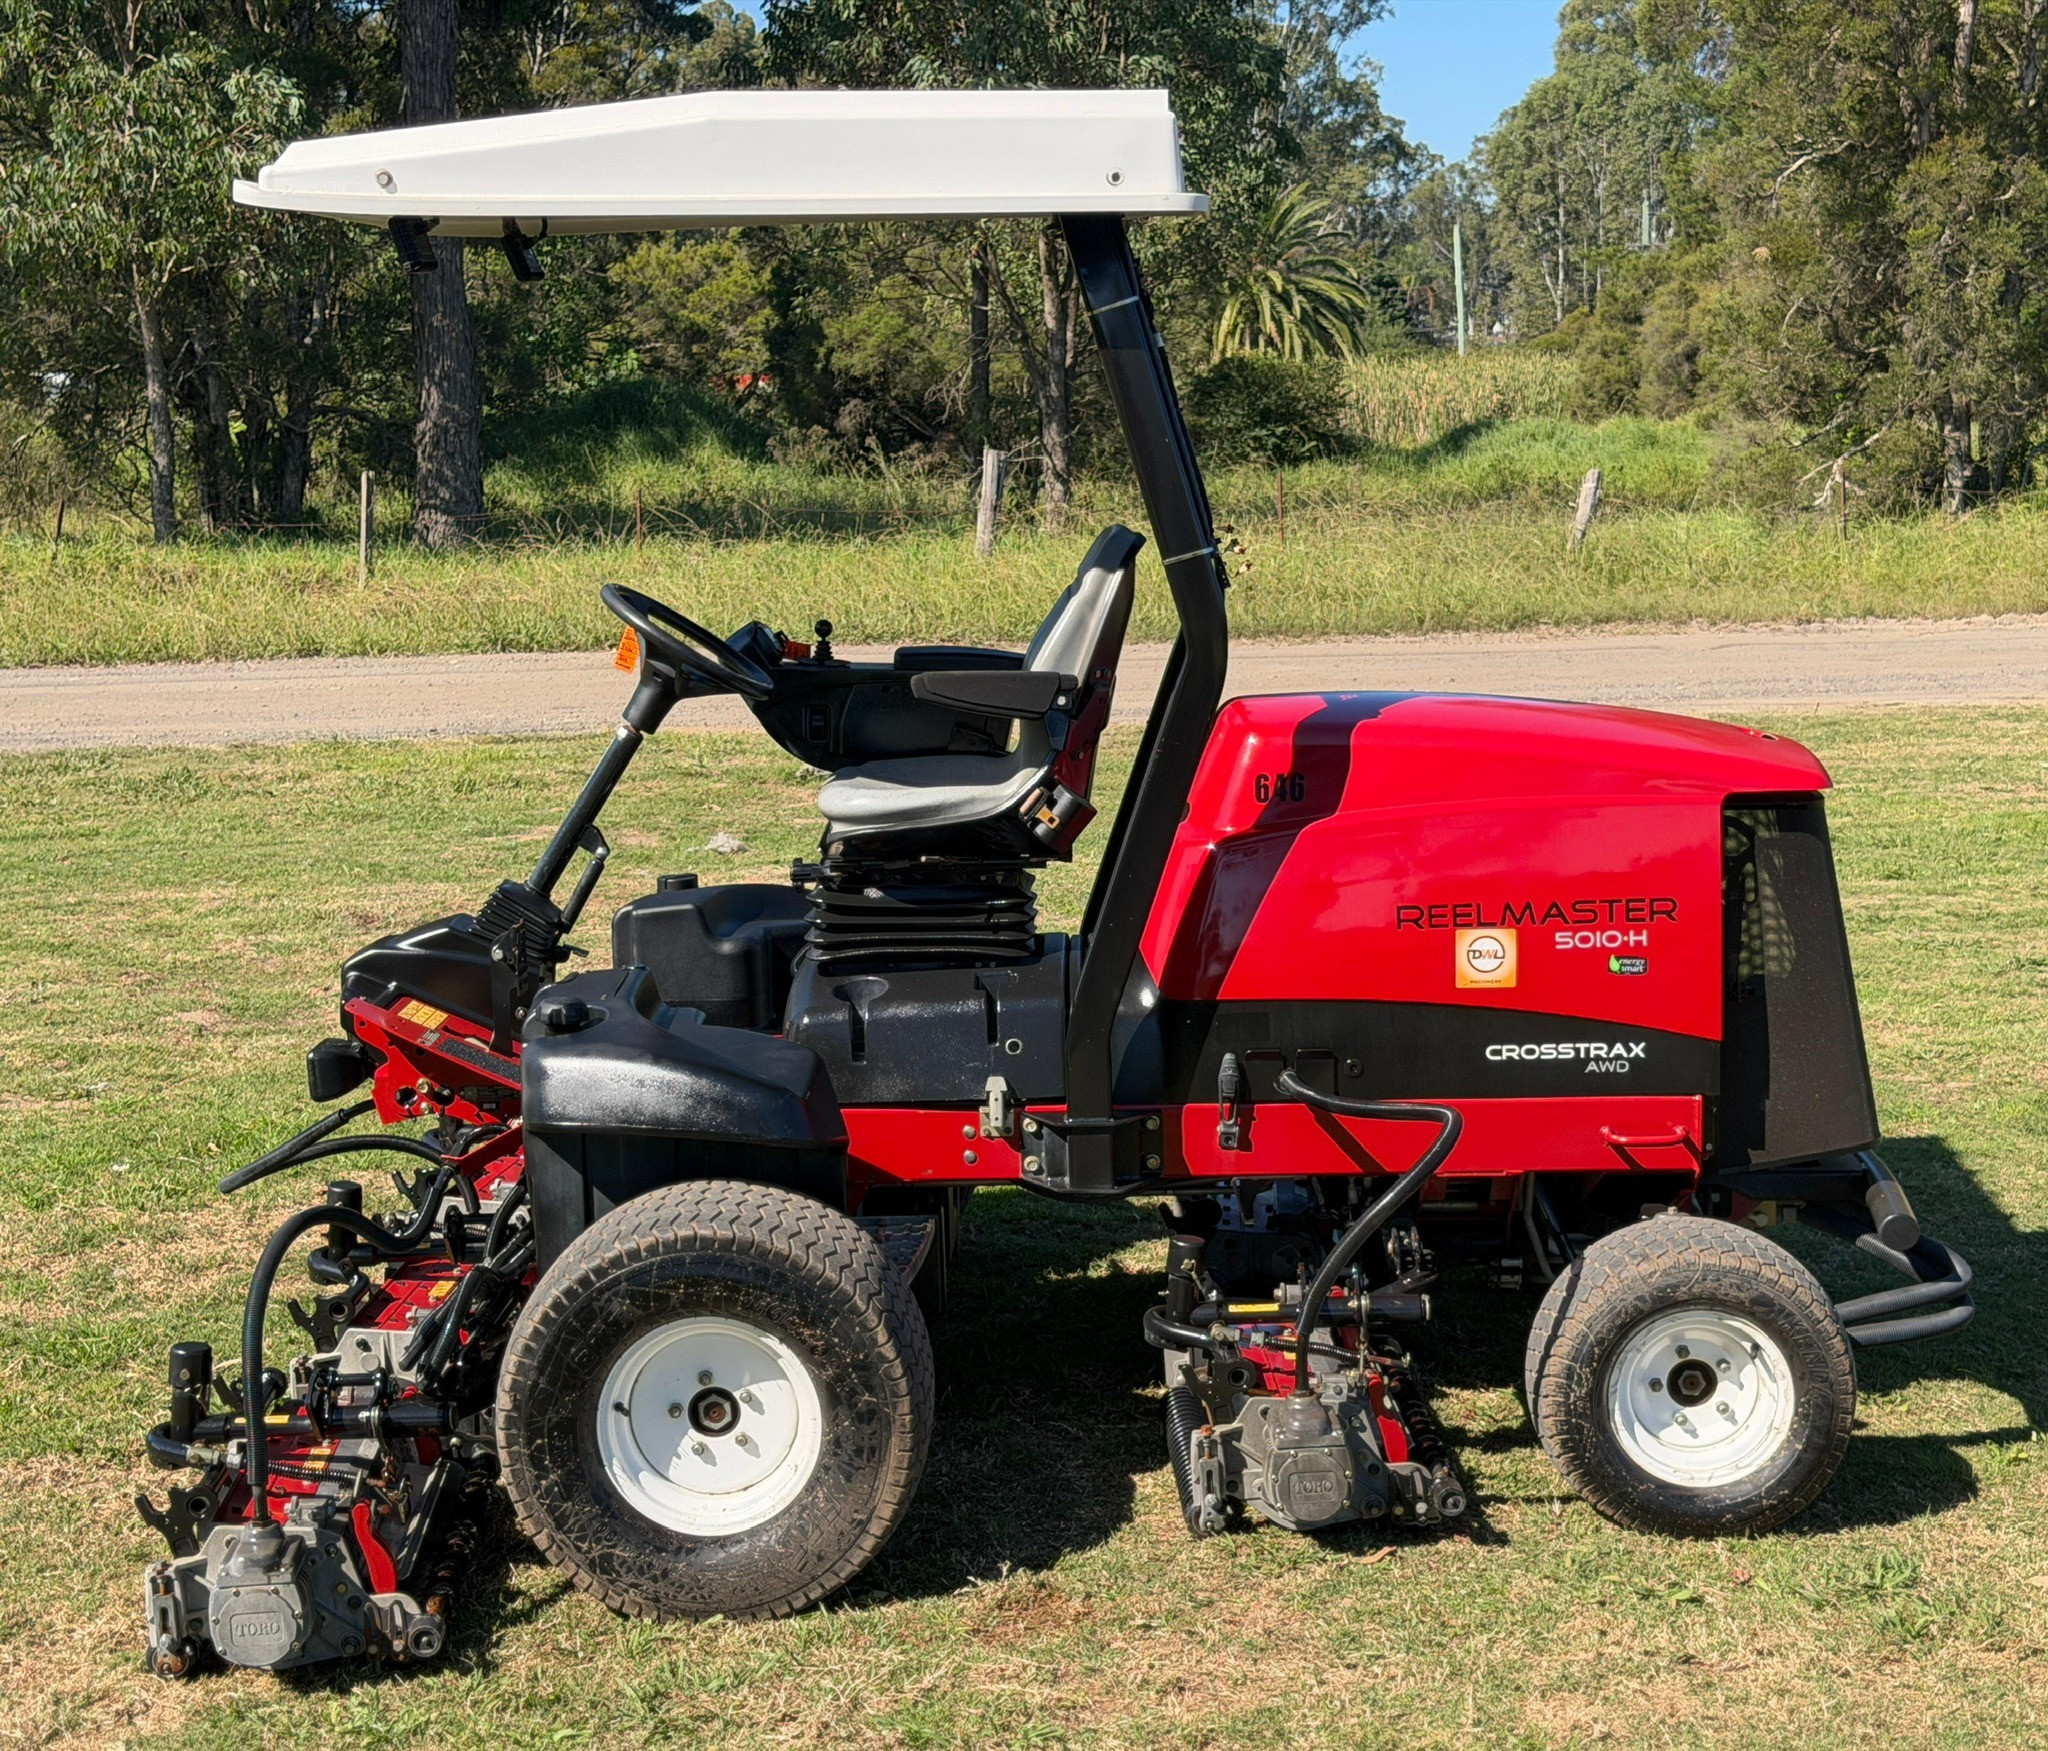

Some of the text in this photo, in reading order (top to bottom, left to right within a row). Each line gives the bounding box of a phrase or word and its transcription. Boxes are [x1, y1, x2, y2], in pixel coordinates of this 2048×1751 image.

[1254, 772, 1305, 803] 646
[1396, 897, 1679, 930] REELMASTER
[1618, 958, 1646, 966] energy
[1621, 965, 1644, 973] smart
[1485, 1042, 1646, 1060] CROSSTRAX
[1584, 1060, 1630, 1073] AWD
[1292, 1480, 1333, 1495] TORO
[235, 1621, 281, 1638] TORO
